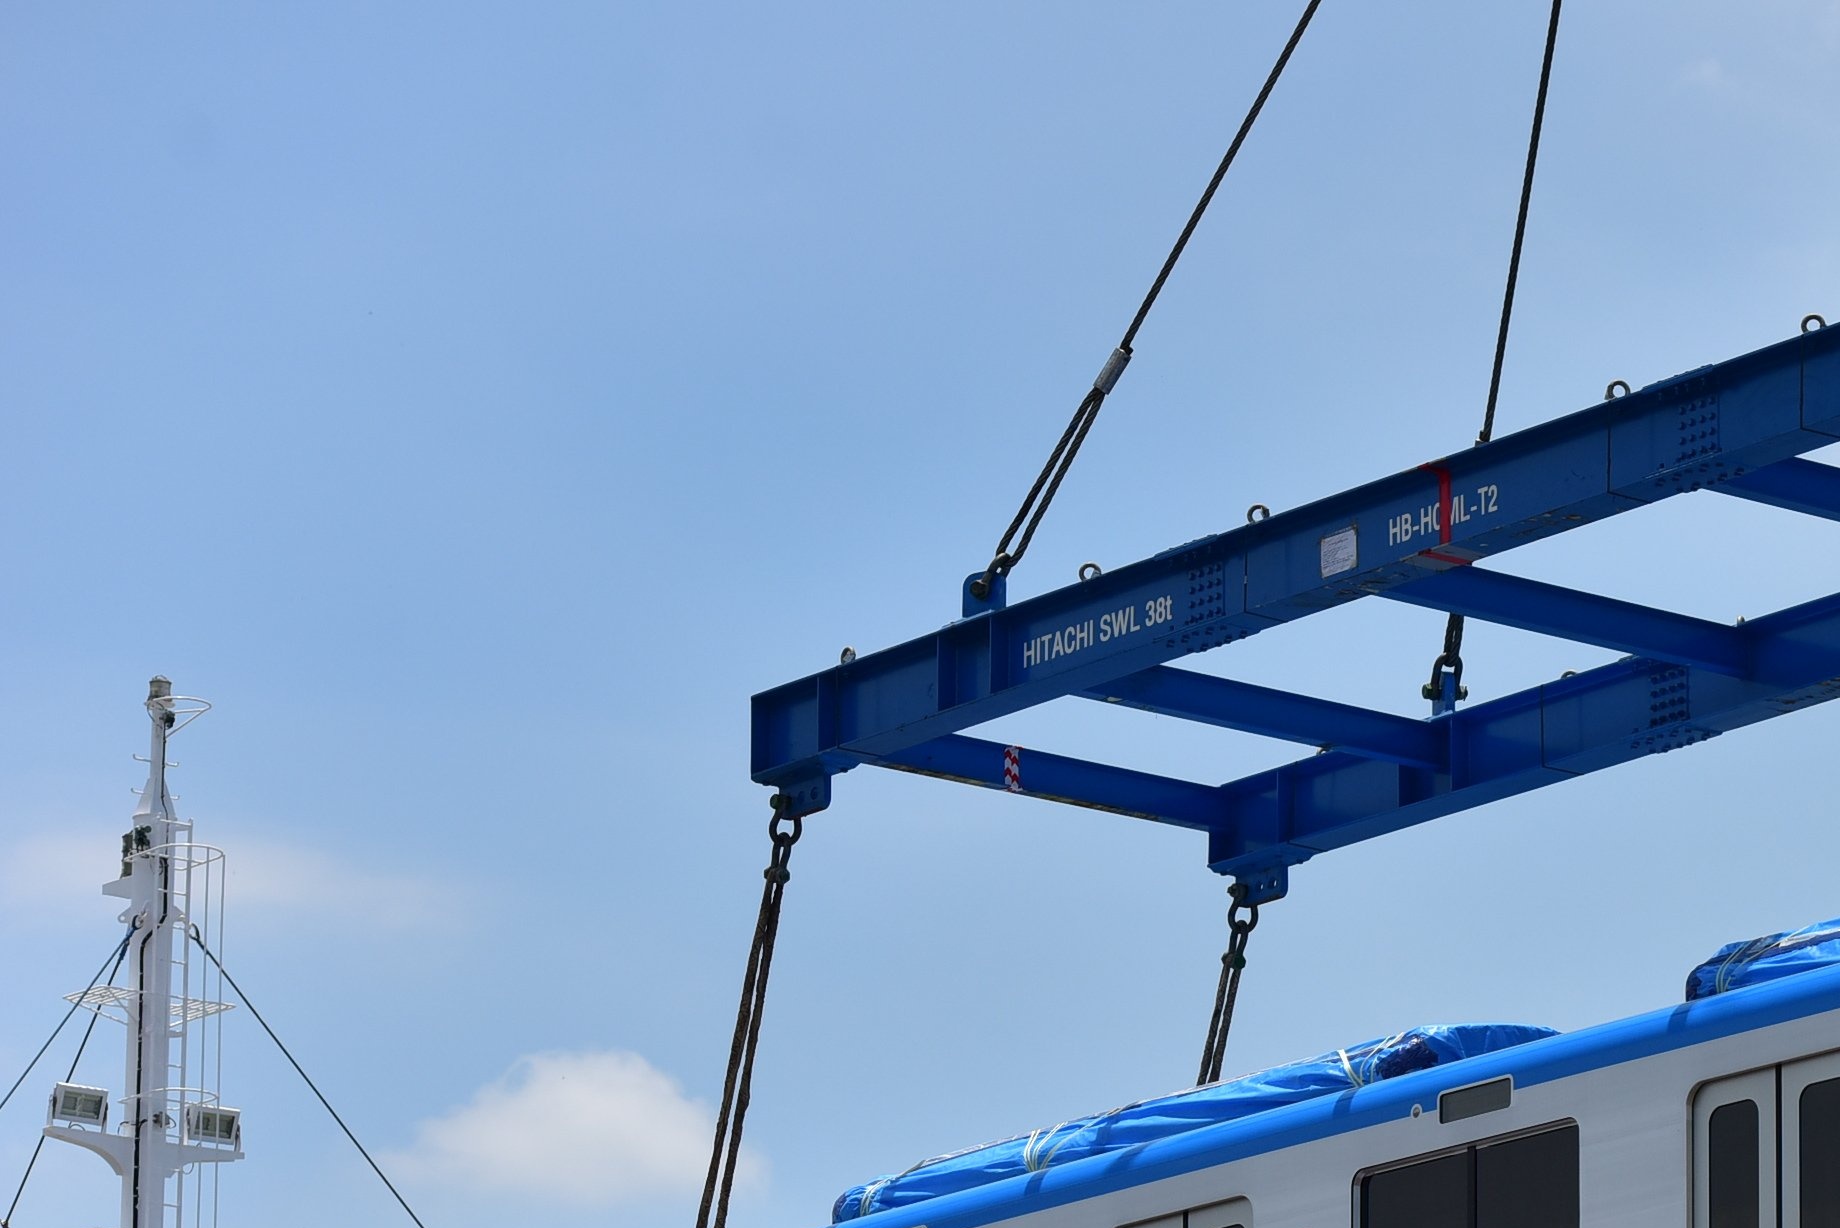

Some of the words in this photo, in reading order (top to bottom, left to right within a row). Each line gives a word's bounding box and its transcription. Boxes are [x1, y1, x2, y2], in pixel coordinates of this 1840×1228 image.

[1023, 619, 1094, 668] HITACHI
[1100, 606, 1140, 642] SWL
[1145, 595, 1173, 627] 38t
